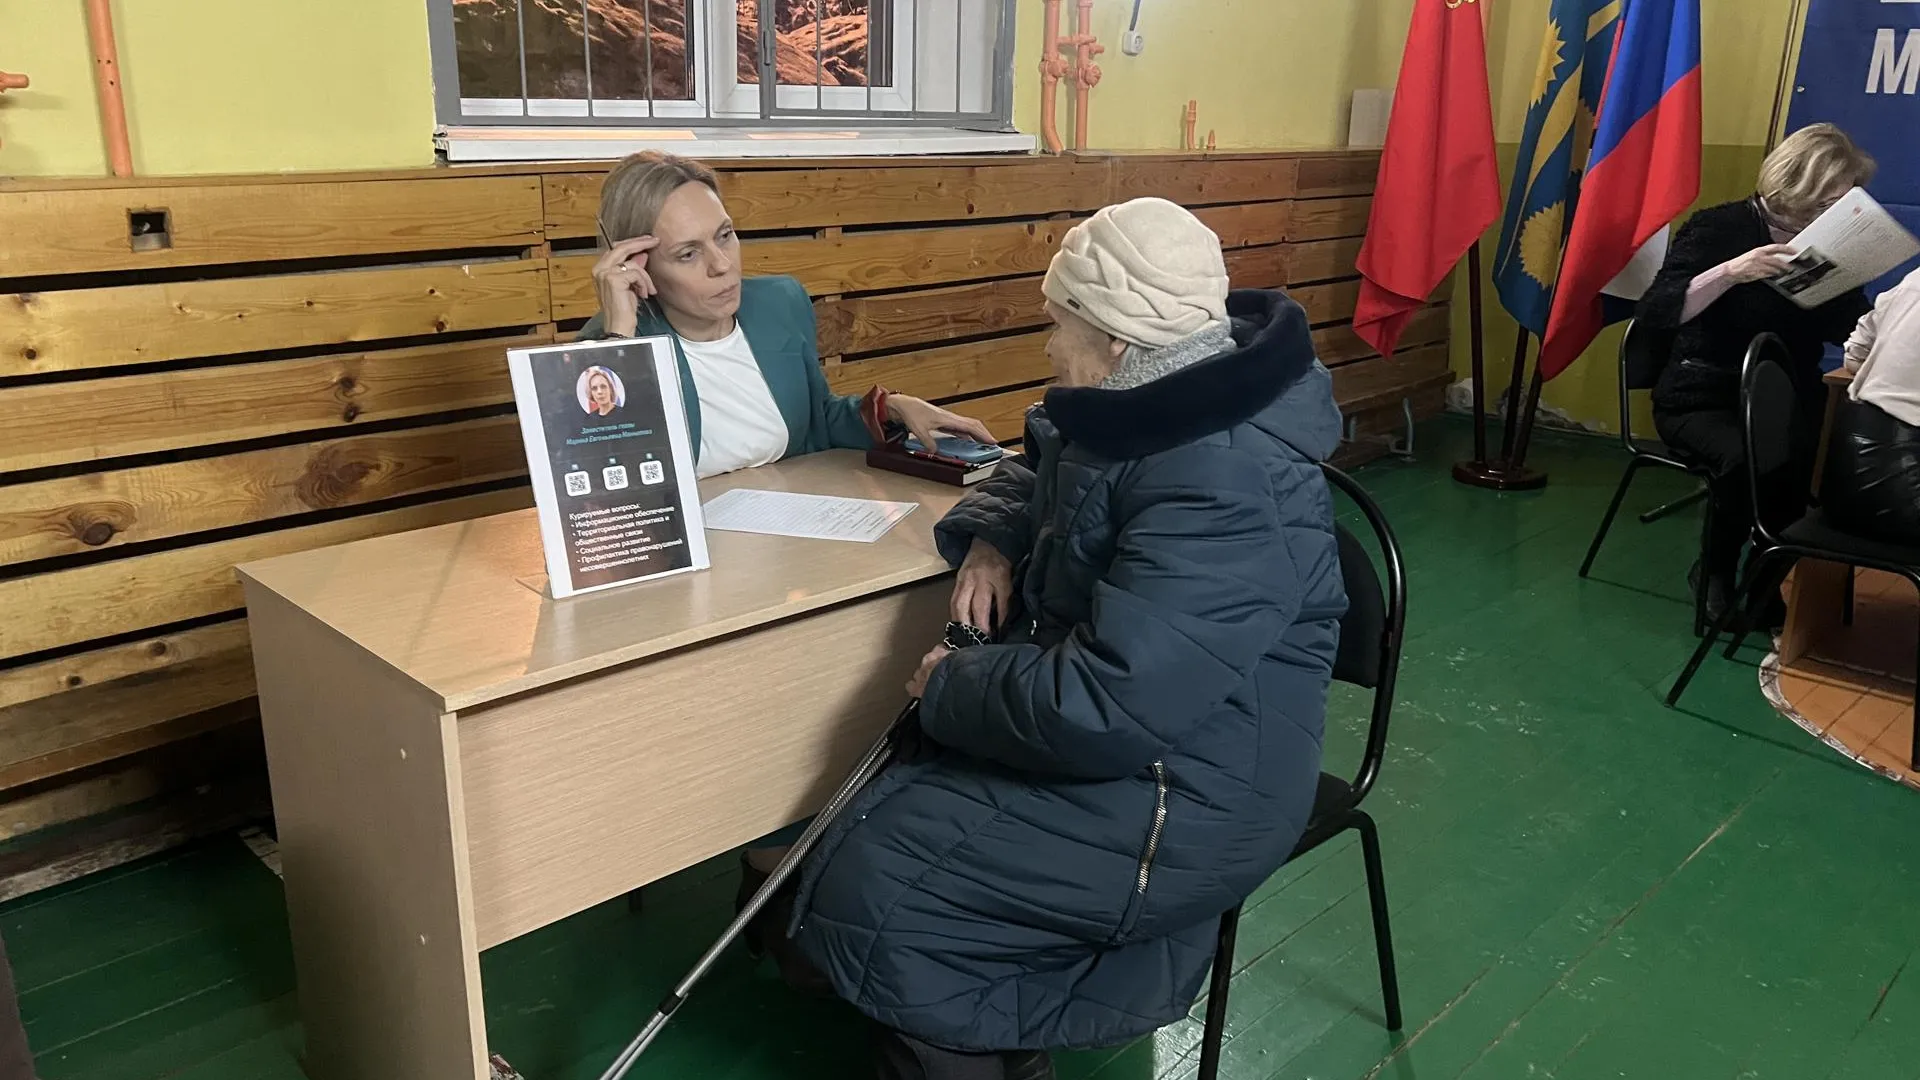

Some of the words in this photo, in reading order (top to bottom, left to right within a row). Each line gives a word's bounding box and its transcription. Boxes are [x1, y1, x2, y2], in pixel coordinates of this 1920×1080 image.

[570, 508, 610, 520] Курируемые
[612, 504, 640, 512] вопросы:
[576, 514, 633, 527] Информационное
[634, 506, 674, 517] обеспечение
[577, 522, 634, 536] Территориальная
[636, 517, 664, 526] политика
[575, 533, 624, 546] общественные
[580, 542, 620, 555] Социальное
[622, 537, 650, 547] развитие
[582, 548, 629, 563] Профилактика
[630, 538, 682, 553] правонарушений
[580, 555, 650, 572] несовершеннолетних
